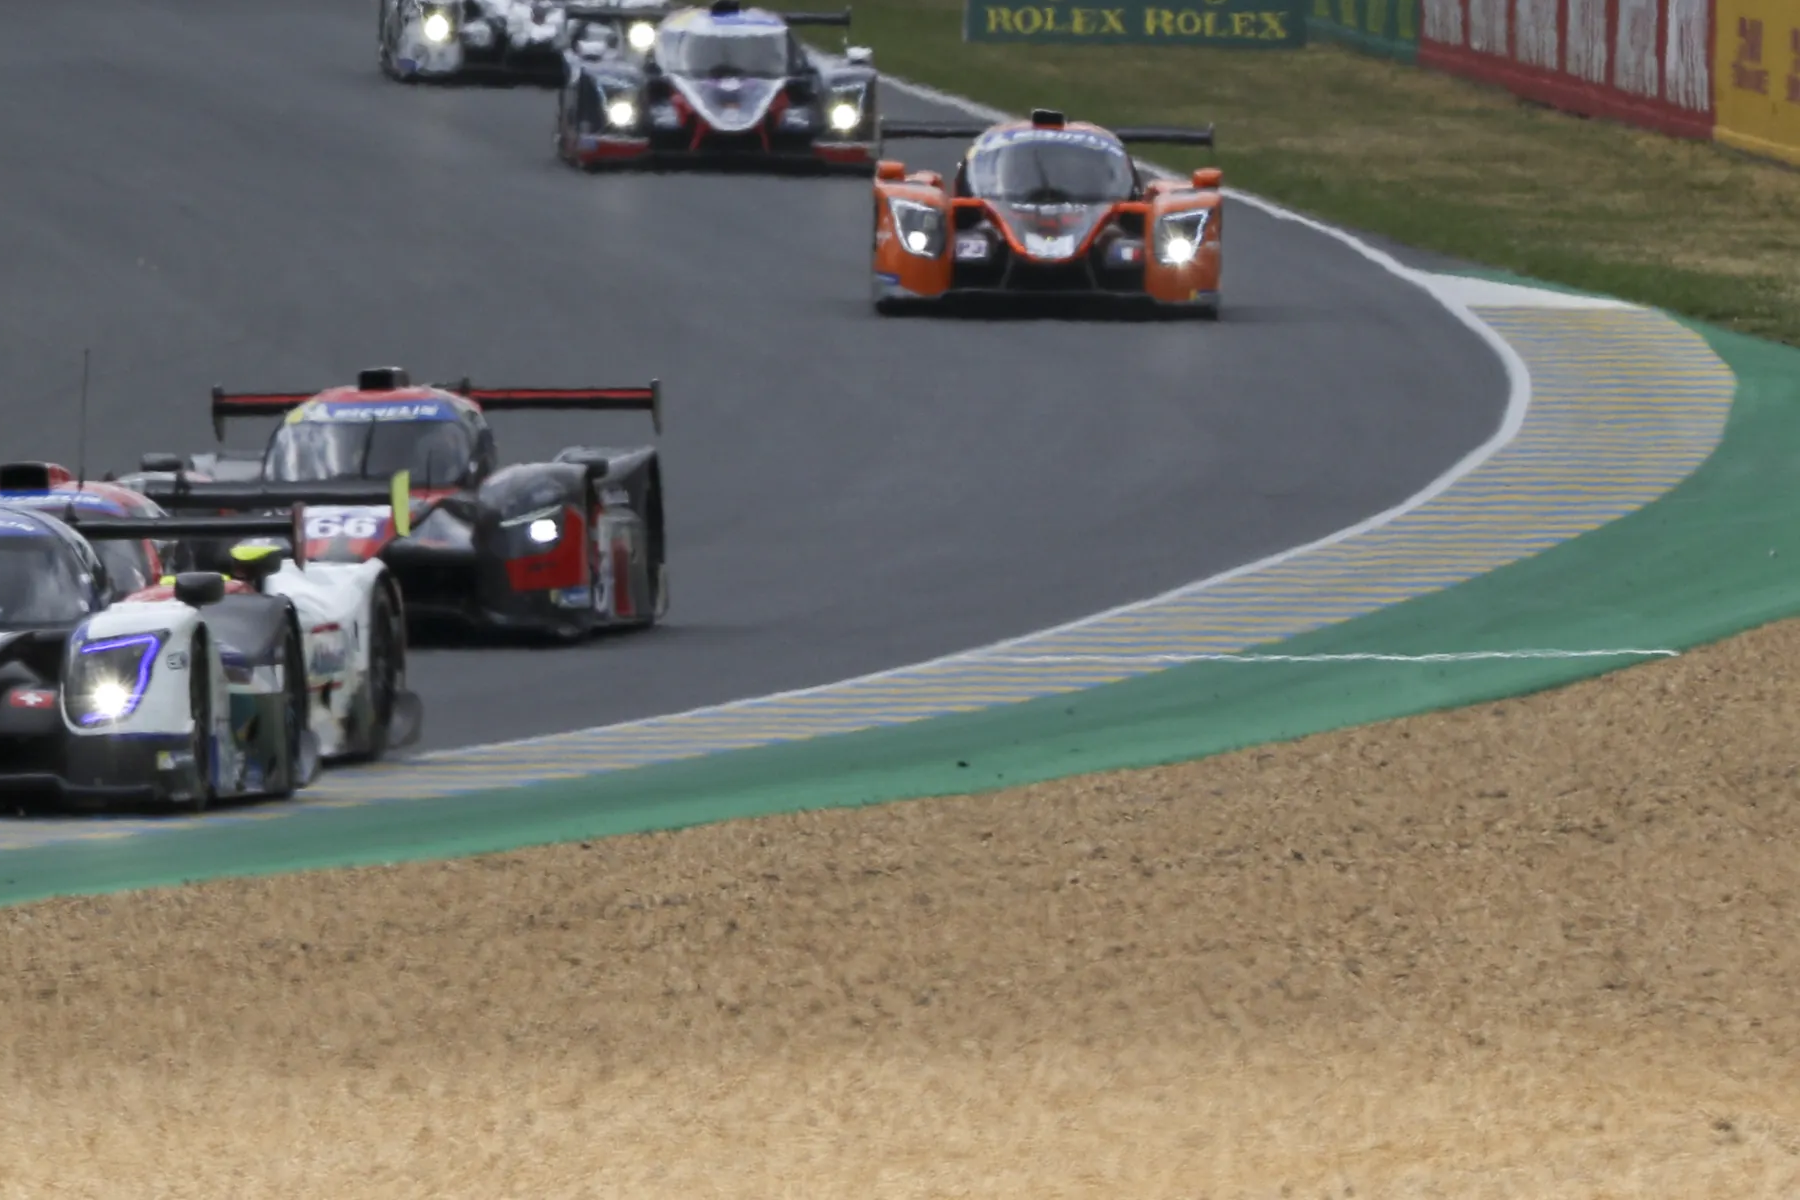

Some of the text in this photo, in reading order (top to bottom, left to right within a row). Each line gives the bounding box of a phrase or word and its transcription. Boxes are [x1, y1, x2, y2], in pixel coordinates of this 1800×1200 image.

[985, 6, 1288, 40] ROLEX ROLEX
[305, 516, 377, 538] 66
